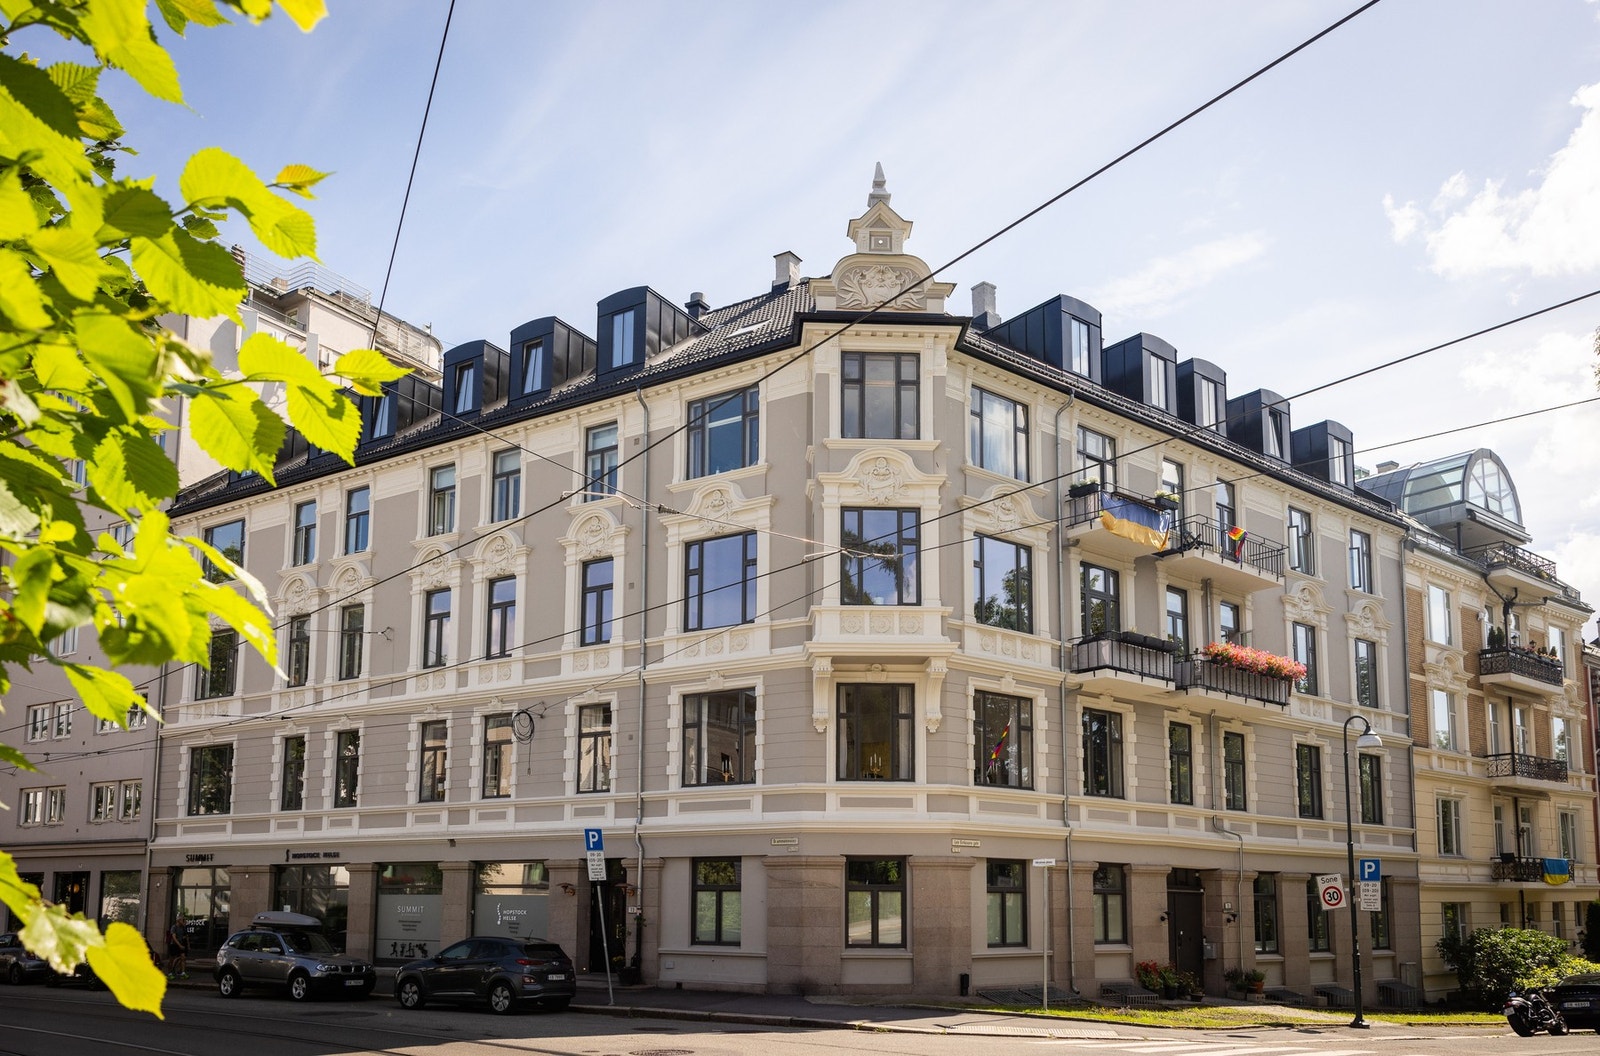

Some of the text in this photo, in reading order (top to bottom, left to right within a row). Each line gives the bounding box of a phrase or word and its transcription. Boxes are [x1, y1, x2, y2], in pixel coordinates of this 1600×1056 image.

[588, 831, 599, 849] P
[186, 853, 214, 863] SUMMIT
[1364, 862, 1376, 879] P
[1326, 891, 1339, 902] 30
[397, 905, 425, 913] SUMMIT
